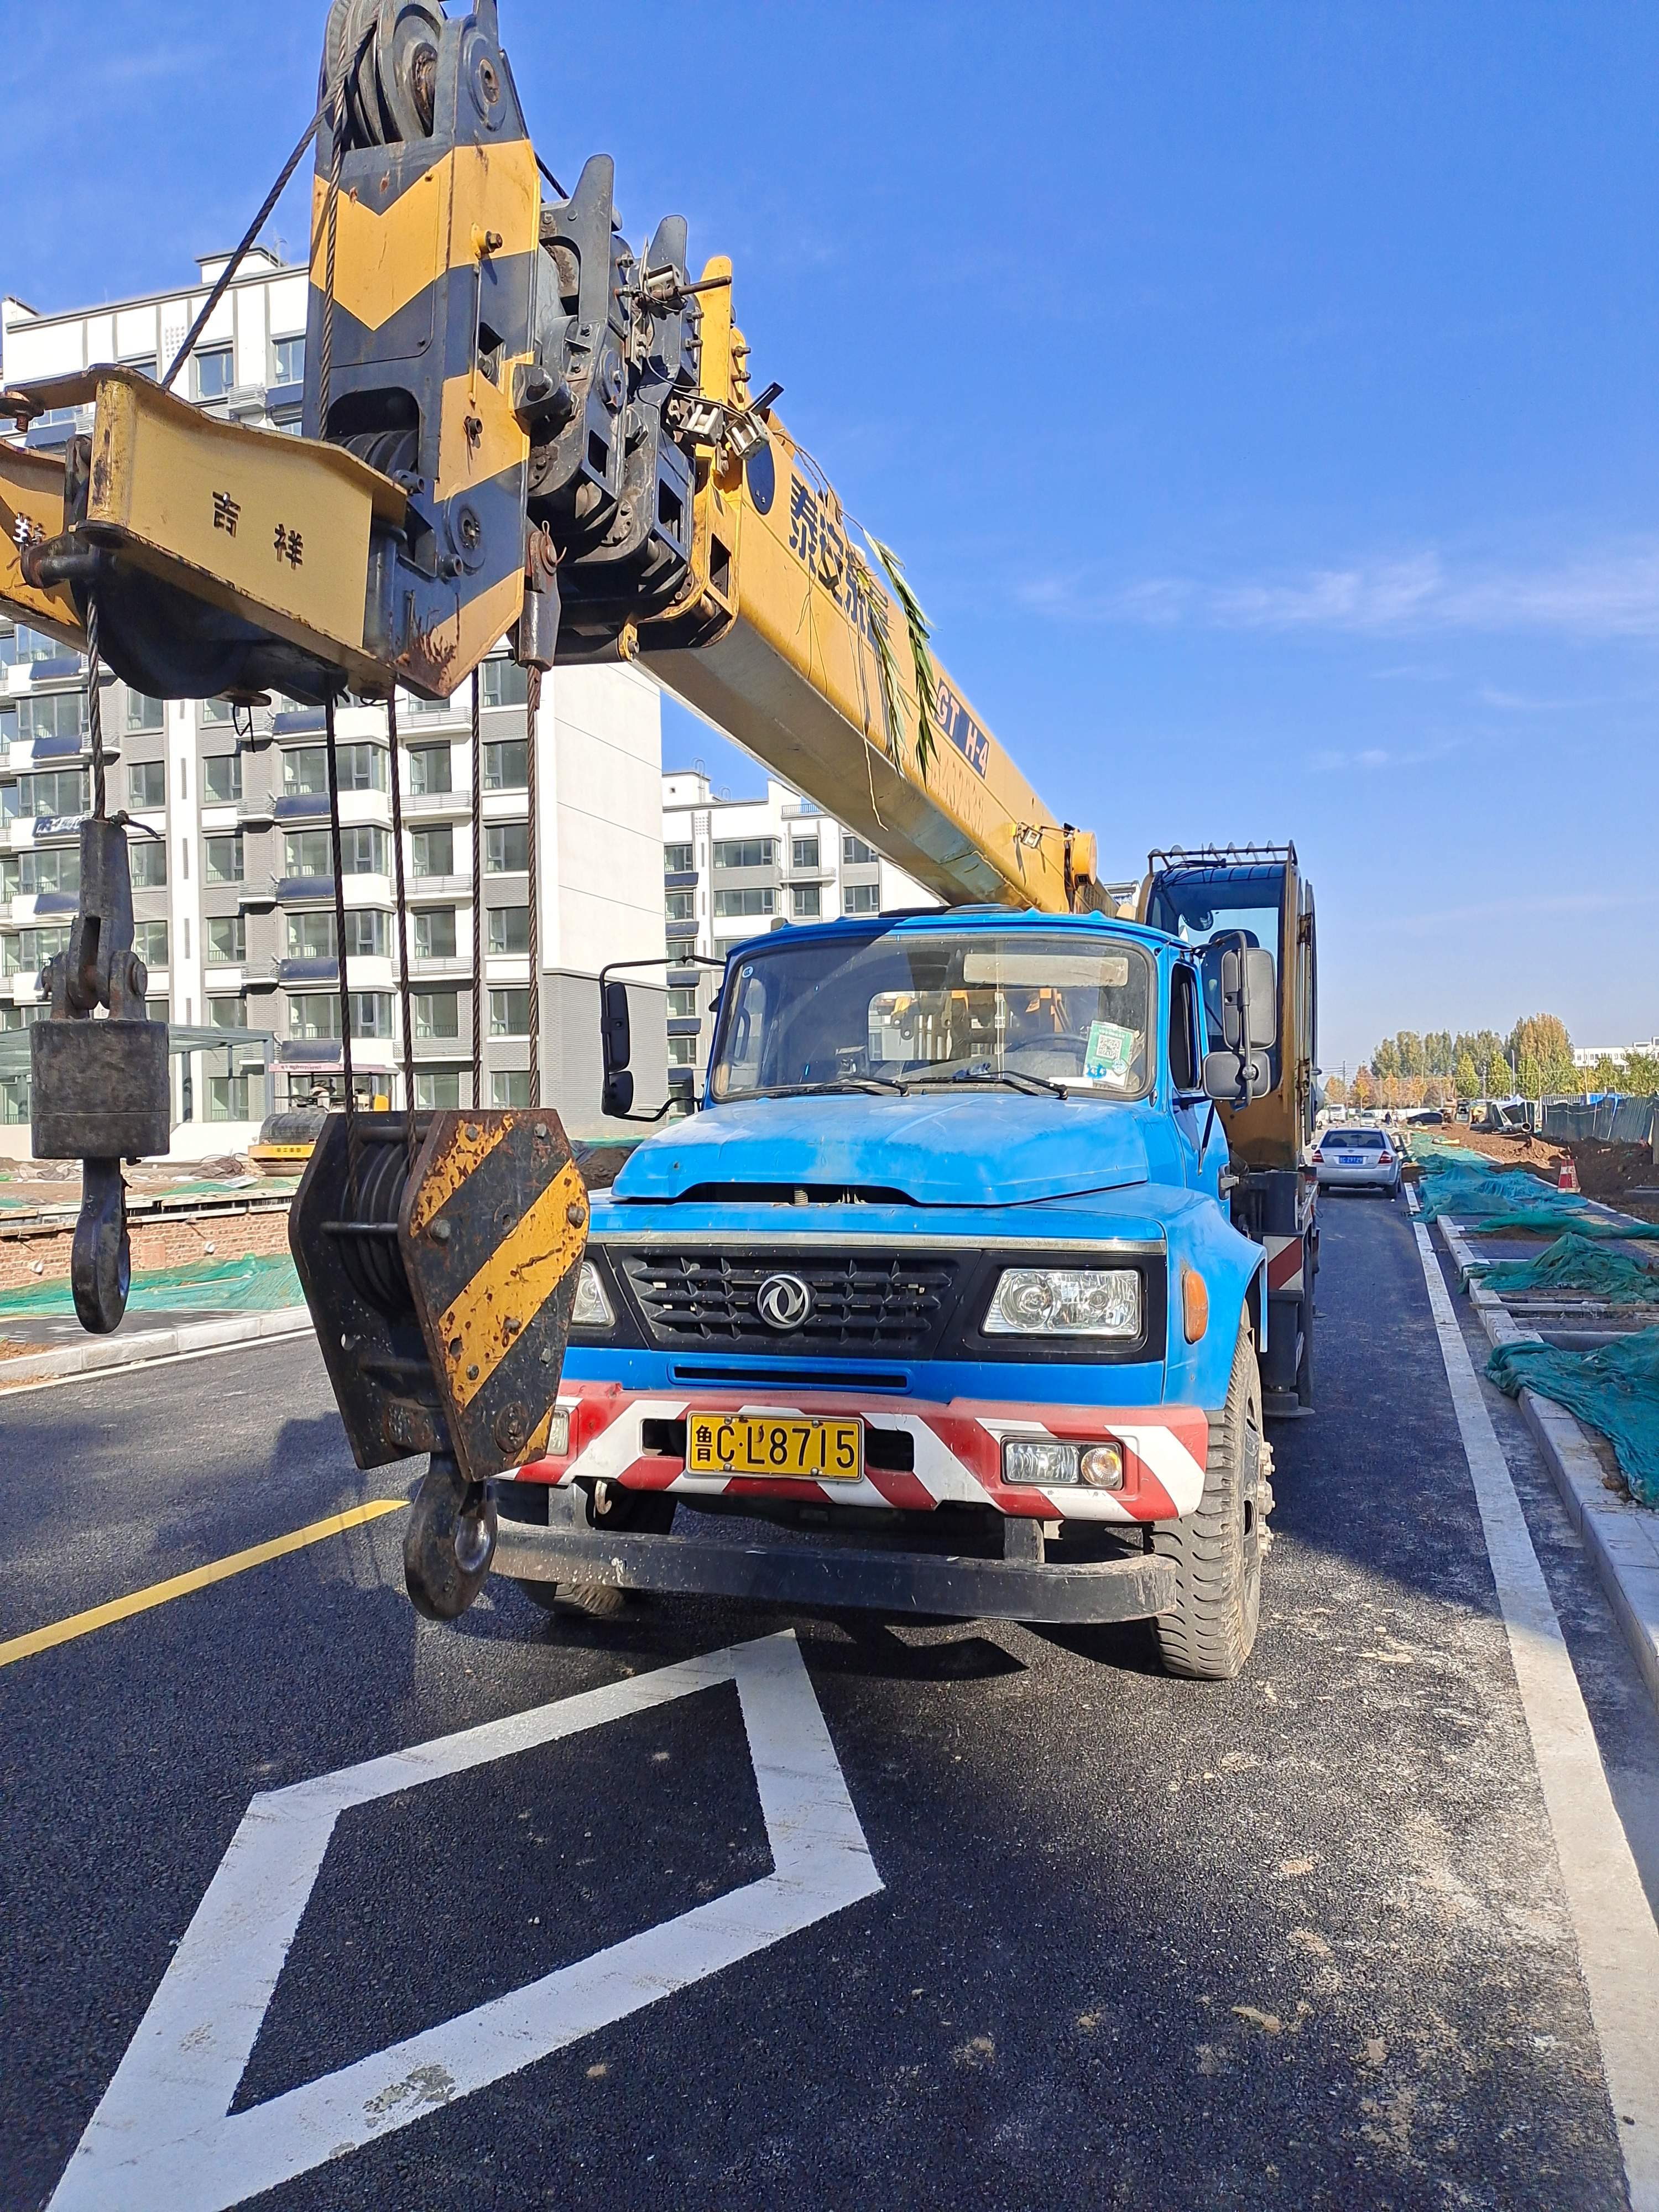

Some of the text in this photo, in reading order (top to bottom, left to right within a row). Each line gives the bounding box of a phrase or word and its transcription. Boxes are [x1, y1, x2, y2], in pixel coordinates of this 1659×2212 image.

[212, 491, 304, 570] 吉祥
[936, 685, 989, 776] GT H-4
